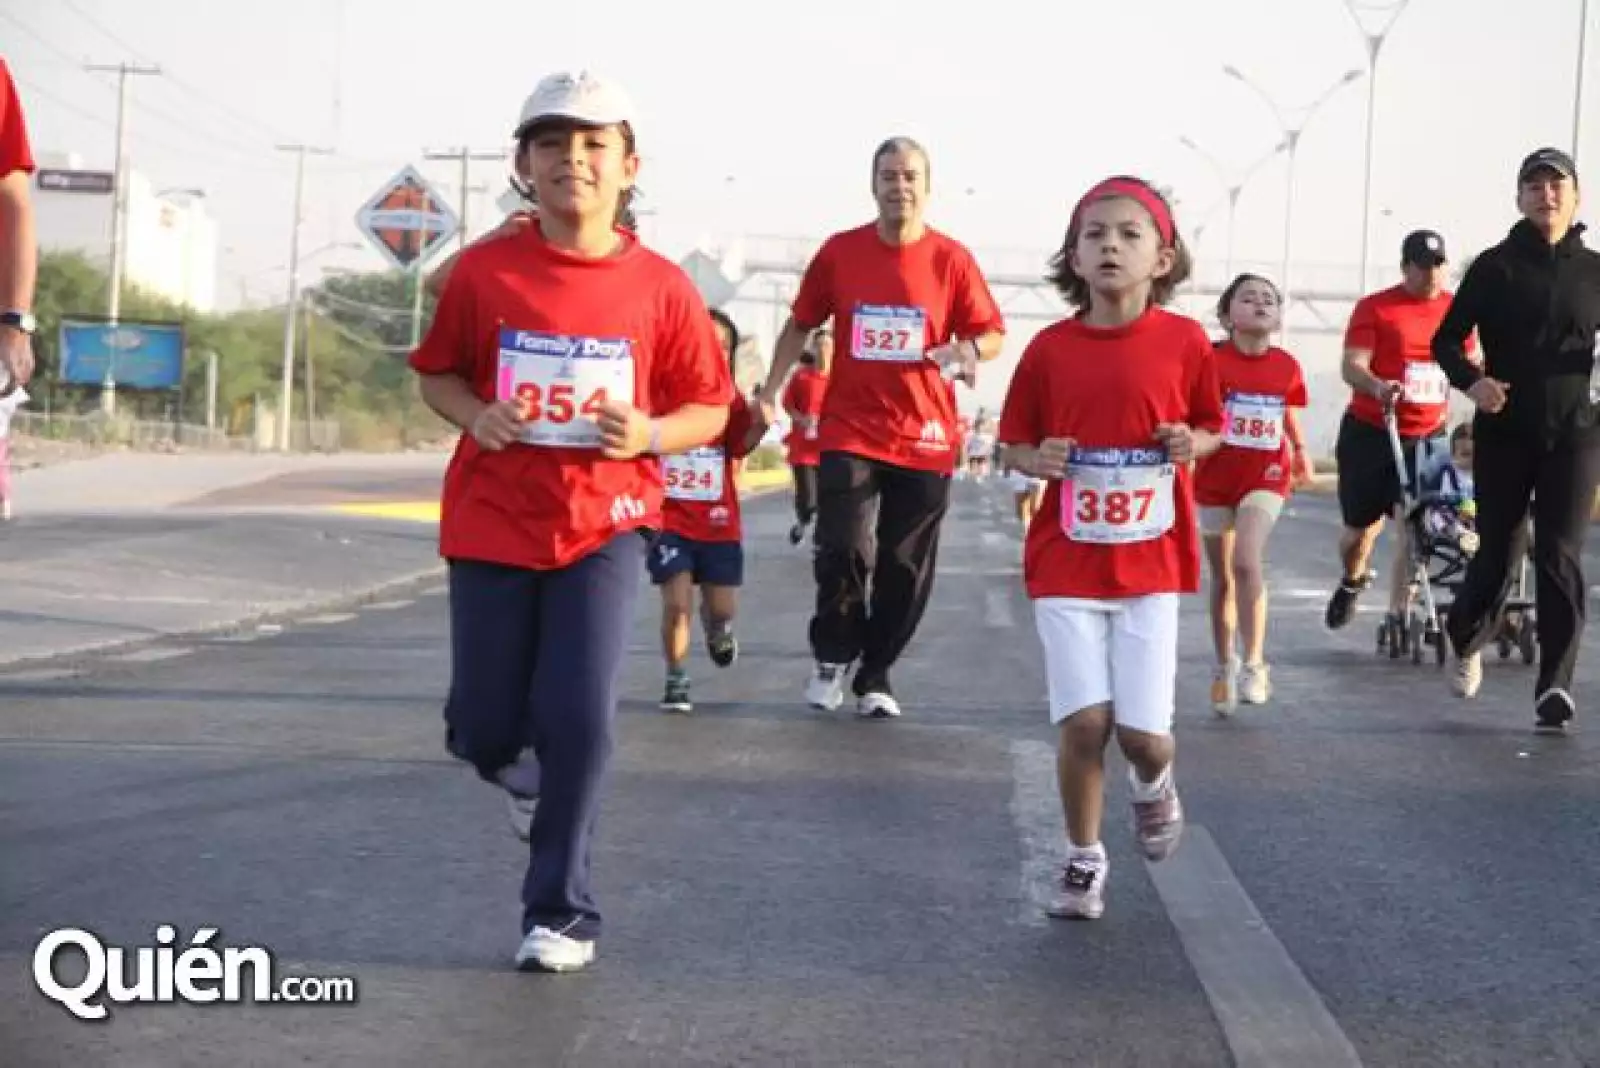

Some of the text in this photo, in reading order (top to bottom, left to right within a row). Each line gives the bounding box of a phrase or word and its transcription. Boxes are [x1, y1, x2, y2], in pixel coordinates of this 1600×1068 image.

[515, 331, 630, 362] Family Day
[864, 330, 910, 351] 527
[1232, 417, 1276, 439] 384
[665, 467, 711, 489] 524
[1077, 487, 1155, 525] 387
